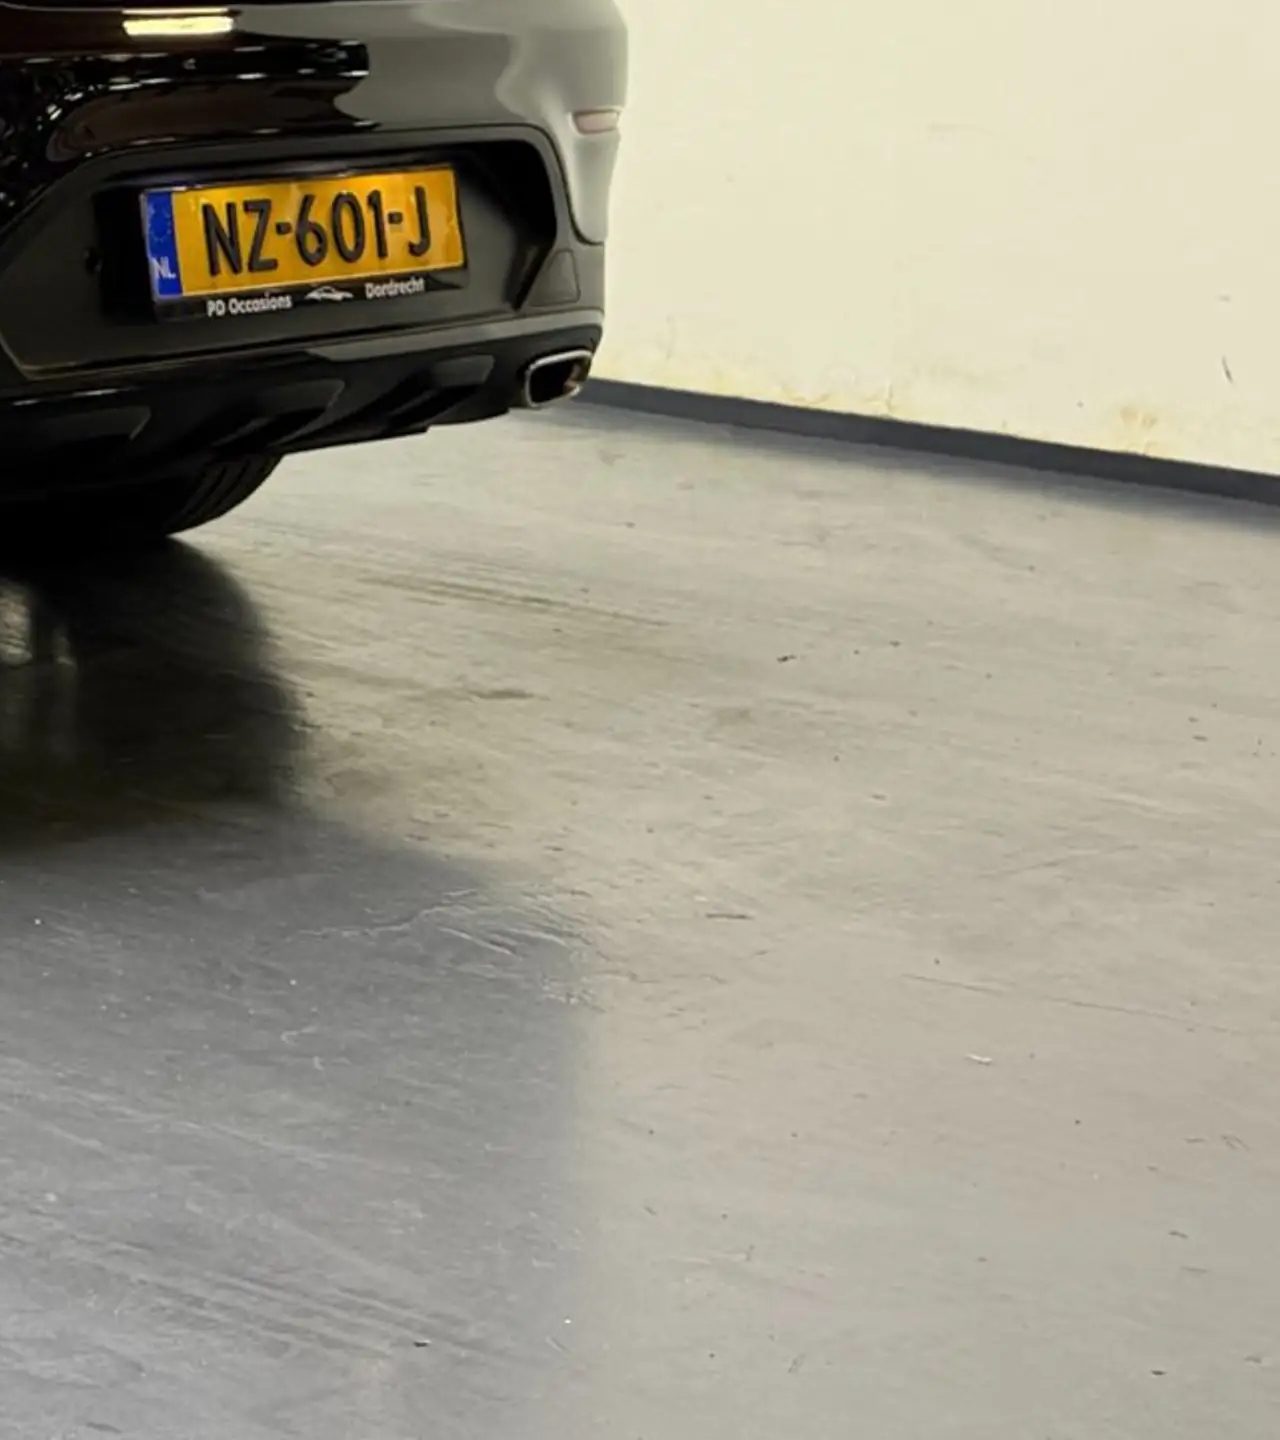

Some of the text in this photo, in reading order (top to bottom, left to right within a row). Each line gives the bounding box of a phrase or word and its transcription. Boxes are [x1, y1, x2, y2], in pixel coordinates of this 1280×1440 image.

[201, 186, 432, 277] NZ-601-J
[151, 257, 177, 279] NL
[206, 277, 425, 317] PD Occasions Dordrecht
